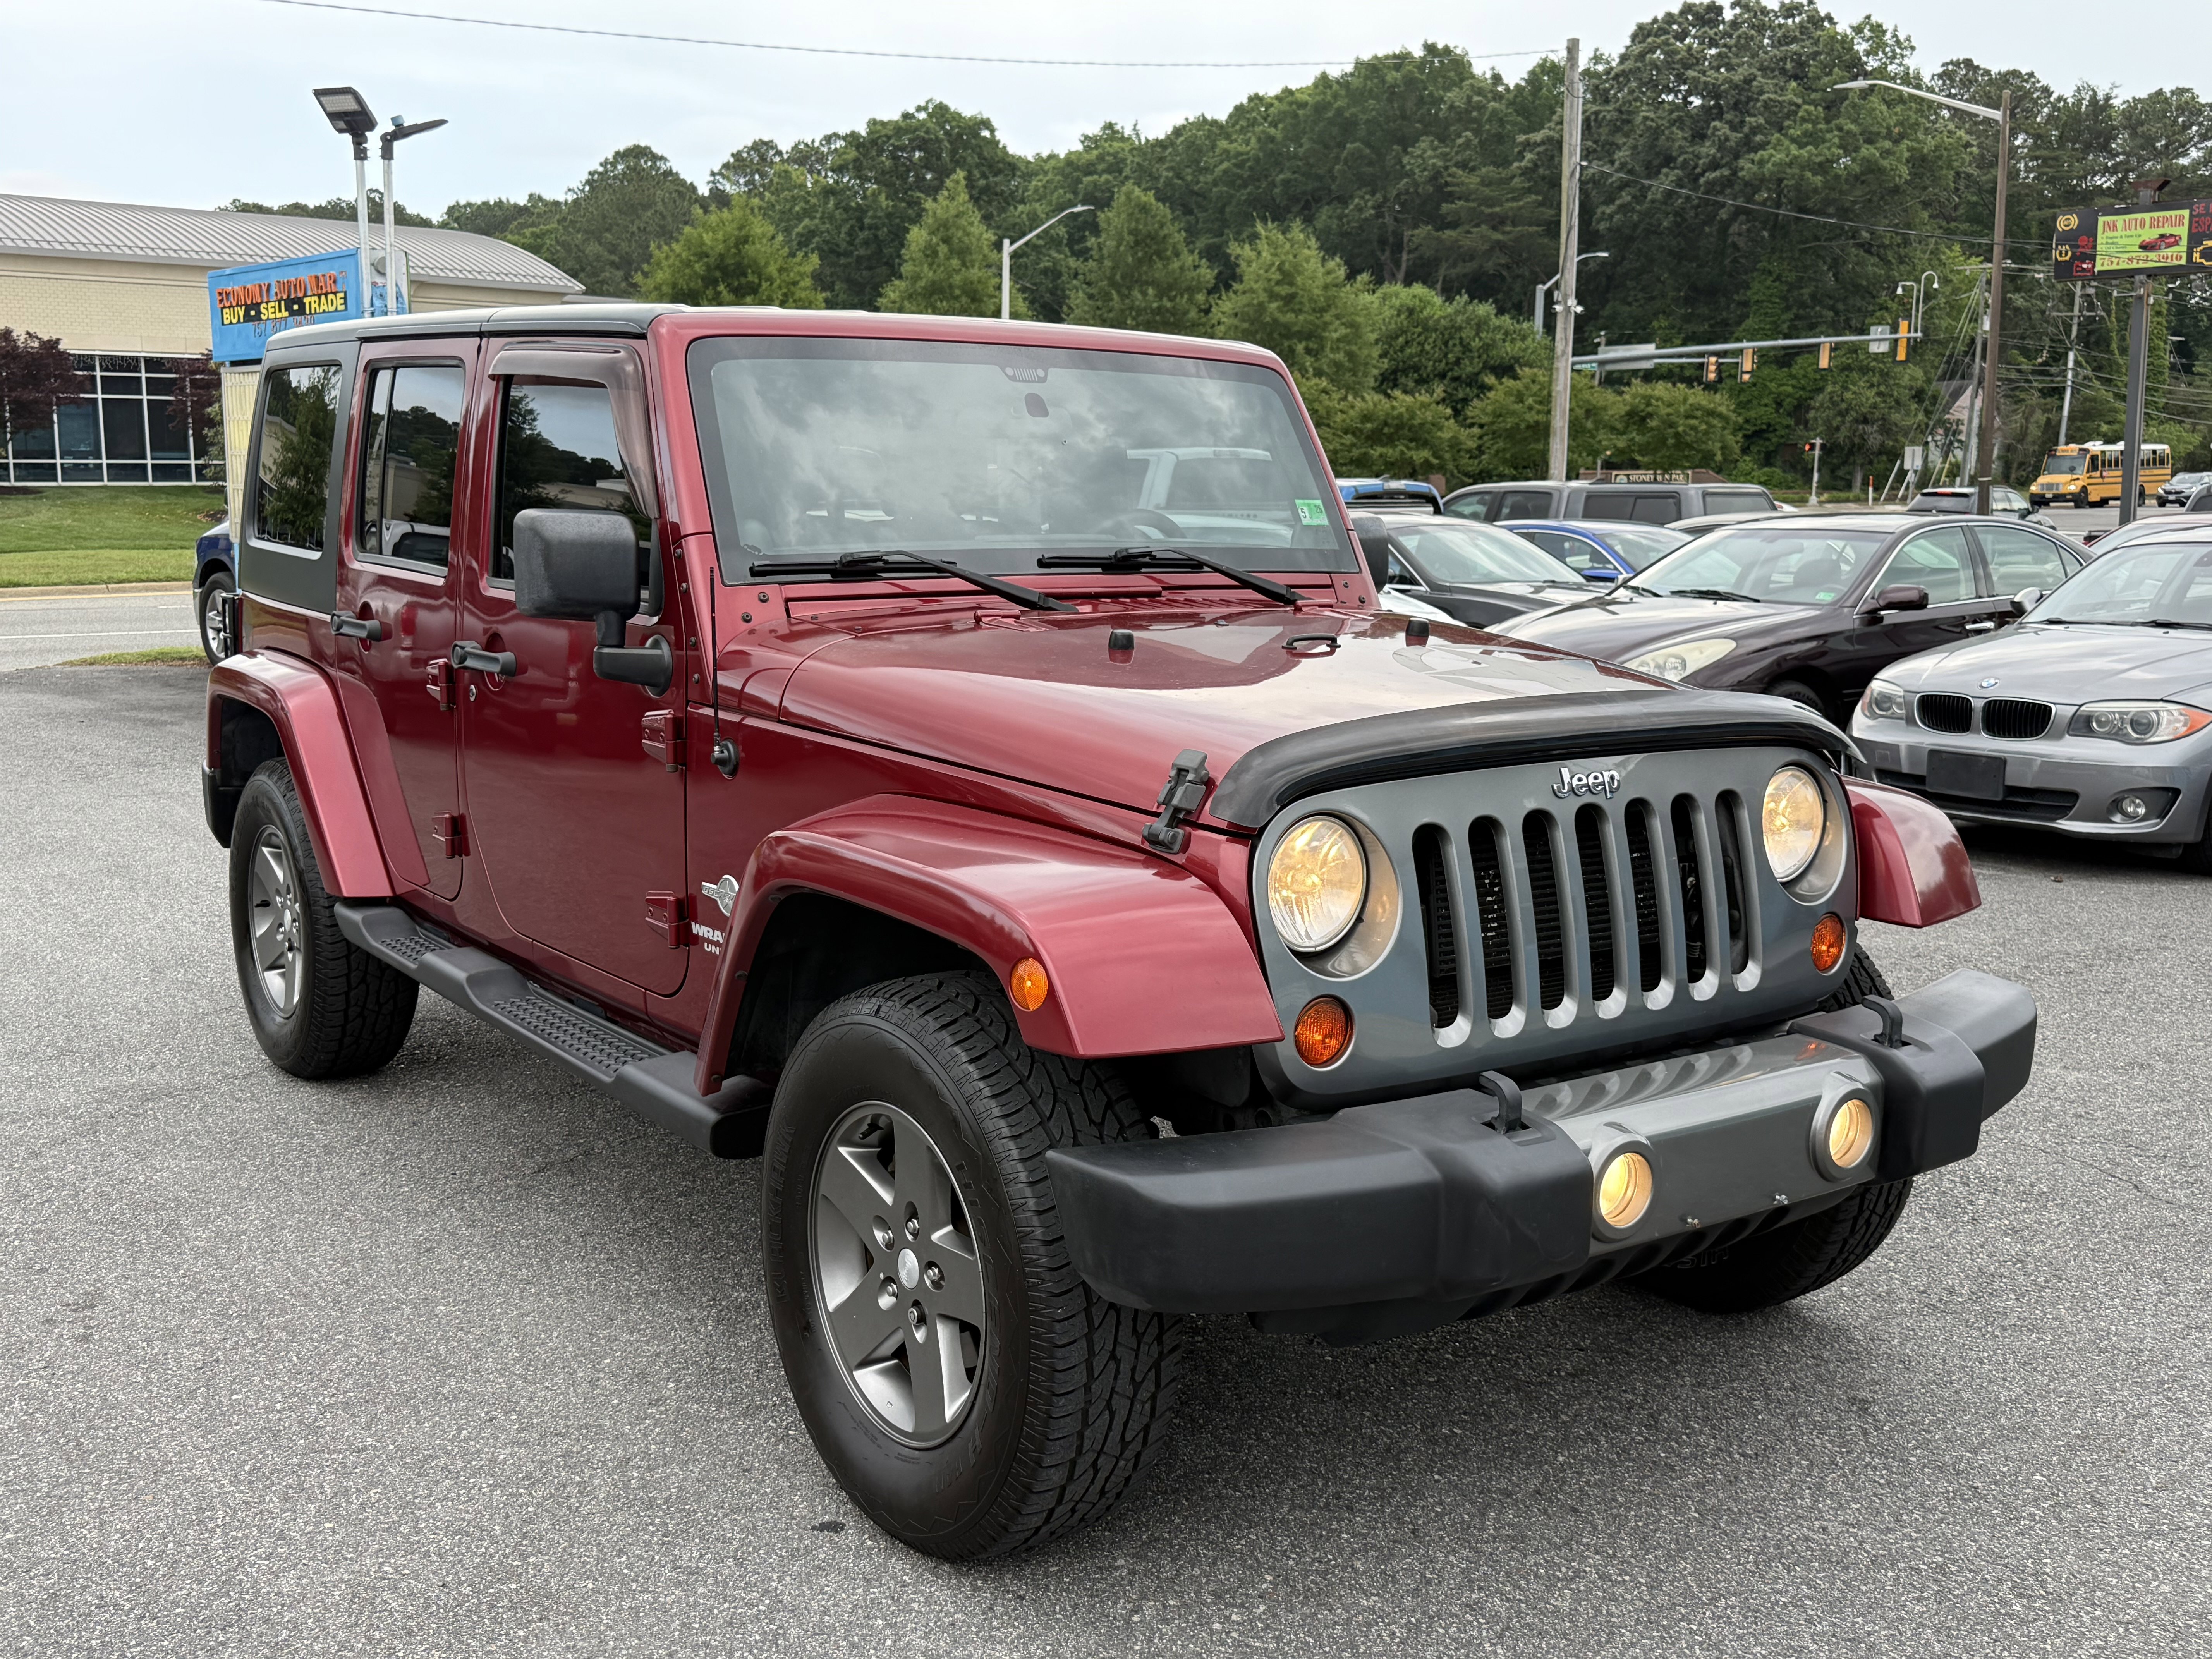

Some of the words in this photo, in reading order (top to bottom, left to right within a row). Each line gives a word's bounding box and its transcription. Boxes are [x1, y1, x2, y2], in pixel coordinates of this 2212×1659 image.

[2121, 217, 2146, 232] AUTO
[2149, 214, 2185, 230] REPAIR
[216, 282, 271, 308] ECONOMY
[274, 276, 306, 300] AUTO
[222, 306, 245, 325] BUY
[260, 301, 289, 320] SELL
[303, 292, 345, 314] TRADE
[1551, 767, 1621, 799] Jeep
[704, 942, 721, 955] UN
